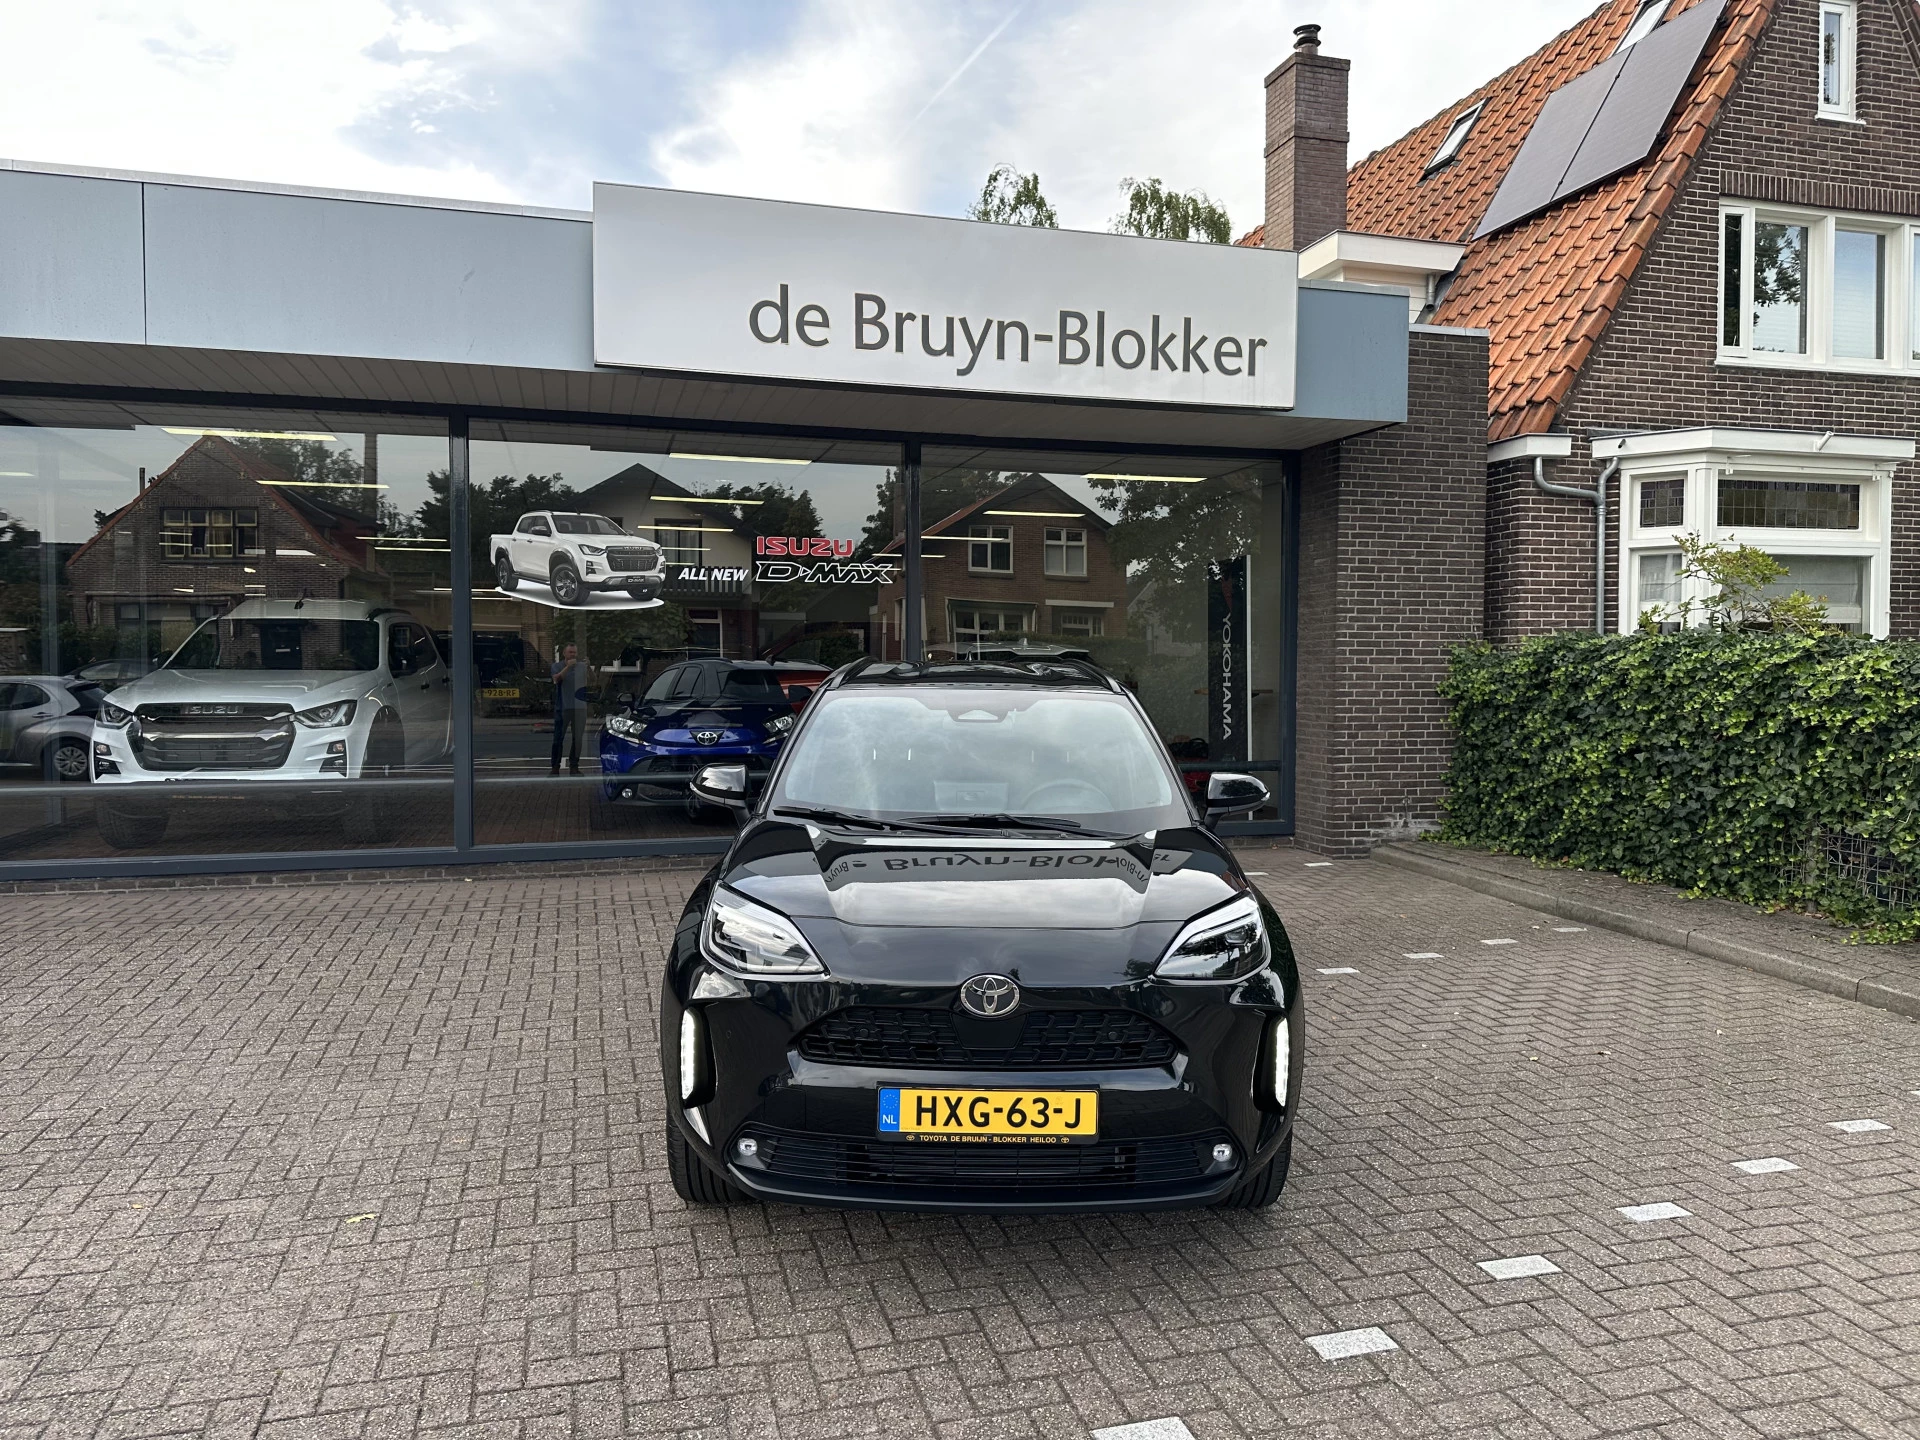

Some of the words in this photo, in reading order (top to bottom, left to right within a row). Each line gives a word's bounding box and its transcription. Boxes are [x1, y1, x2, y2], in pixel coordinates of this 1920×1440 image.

[748, 283, 831, 347] de
[853, 292, 1268, 377] Bruyn-Blokker
[757, 536, 854, 557] ISUZU
[678, 568, 708, 581] ALL
[711, 568, 750, 581] NEW
[1222, 612, 1232, 740] YOKOHAMA
[184, 705, 239, 714] ISUZU
[882, 1114, 897, 1124] NL
[915, 1095, 1081, 1129] HXG-63-J
